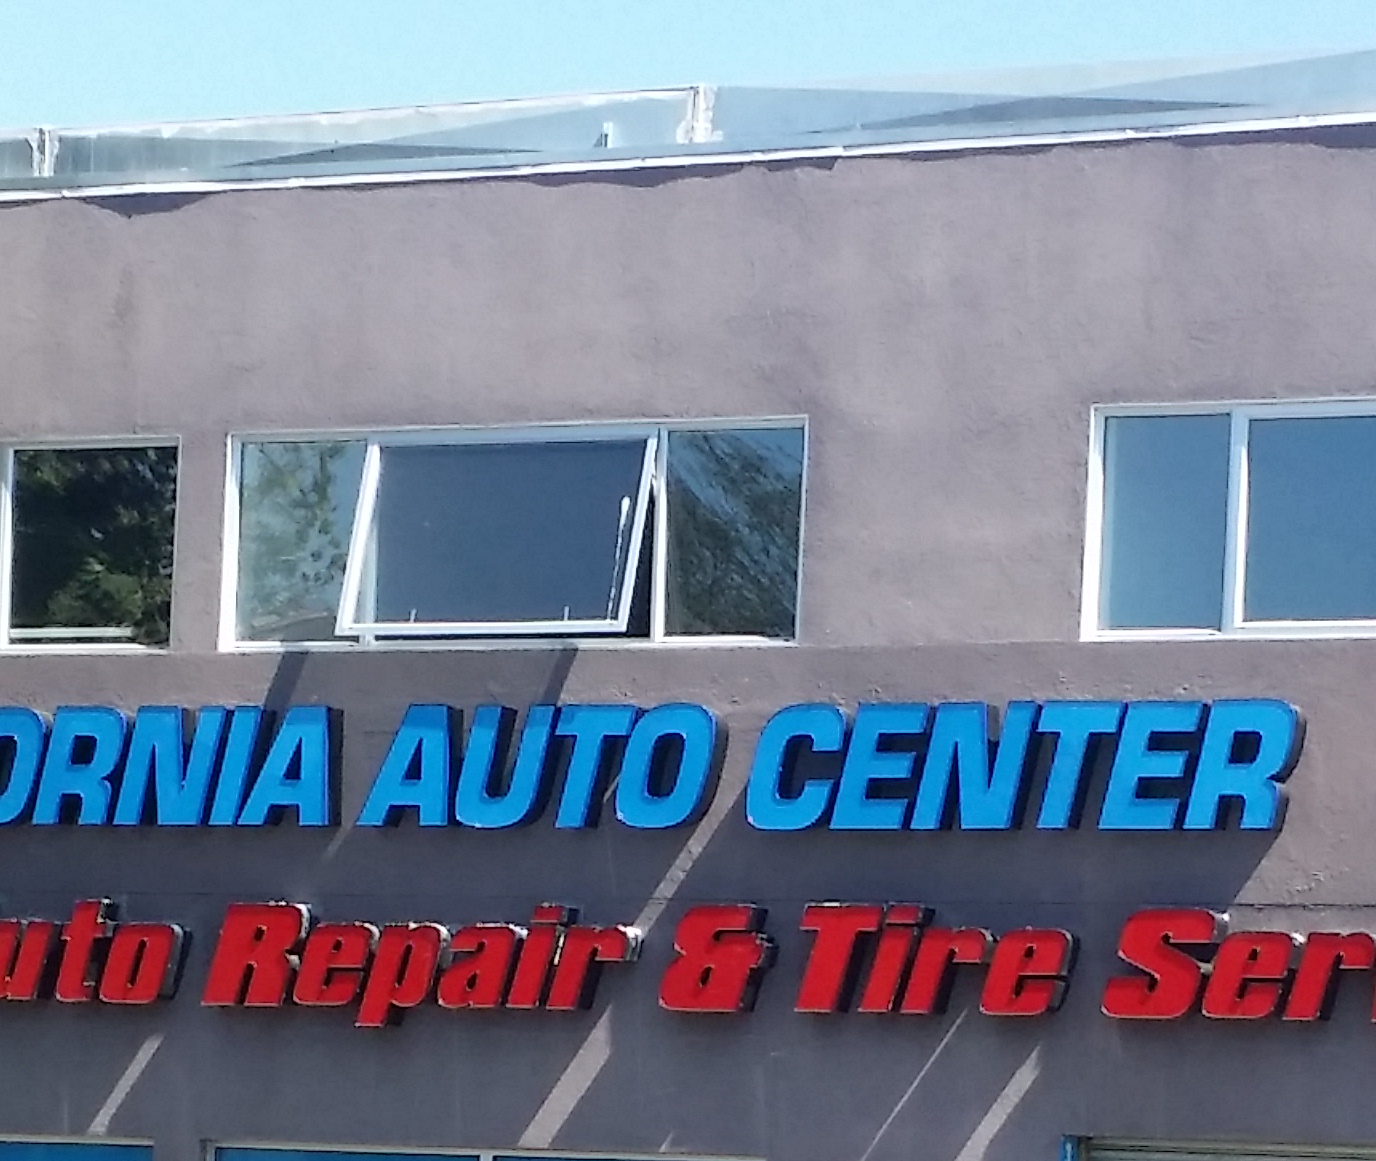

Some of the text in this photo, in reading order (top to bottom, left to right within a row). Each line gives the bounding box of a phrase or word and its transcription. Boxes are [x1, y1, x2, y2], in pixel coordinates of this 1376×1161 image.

[356, 702, 720, 830] AUTO
[745, 700, 1302, 831] CENTER
[202, 902, 638, 1028] Repair
[658, 903, 772, 1012] &
[795, 901, 1076, 1017] Tire
